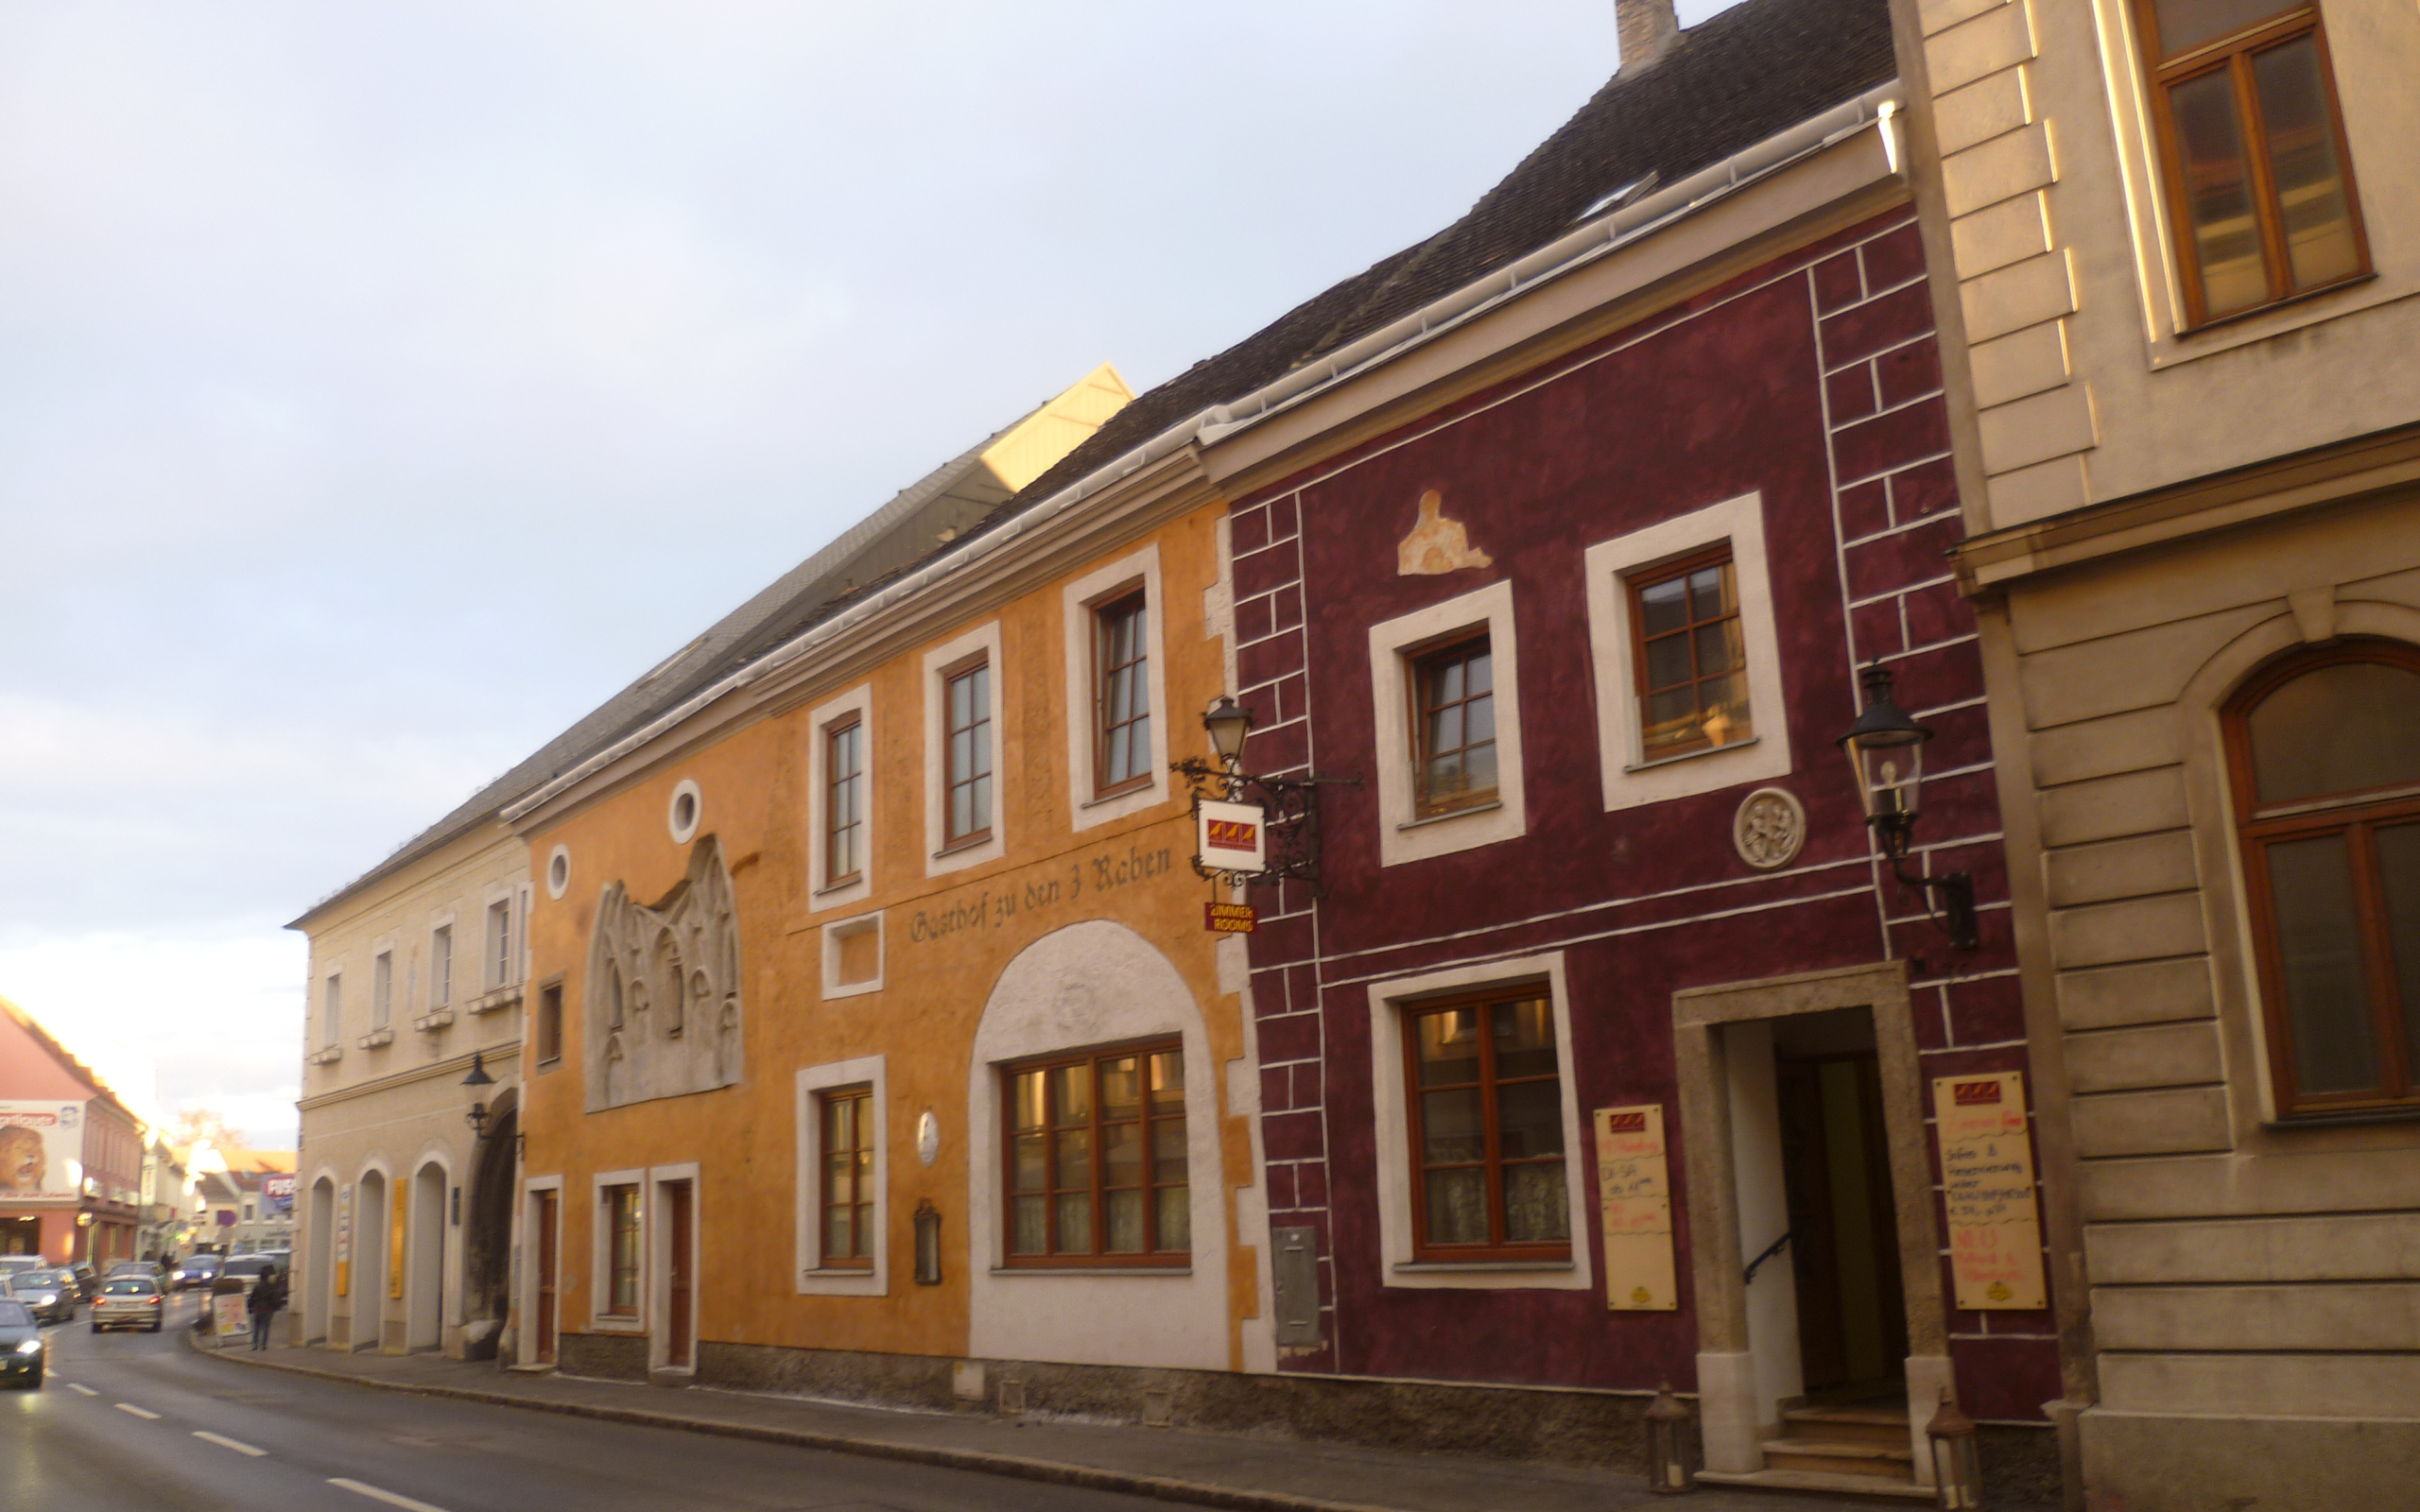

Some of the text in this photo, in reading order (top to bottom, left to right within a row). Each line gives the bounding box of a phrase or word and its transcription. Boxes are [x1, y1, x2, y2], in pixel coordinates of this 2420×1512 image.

[910, 846, 1171, 942] Gasthof zu den 3 Raben
[1210, 904, 1253, 919] ZIMMER
[1214, 918, 1253, 933] ROOMS
